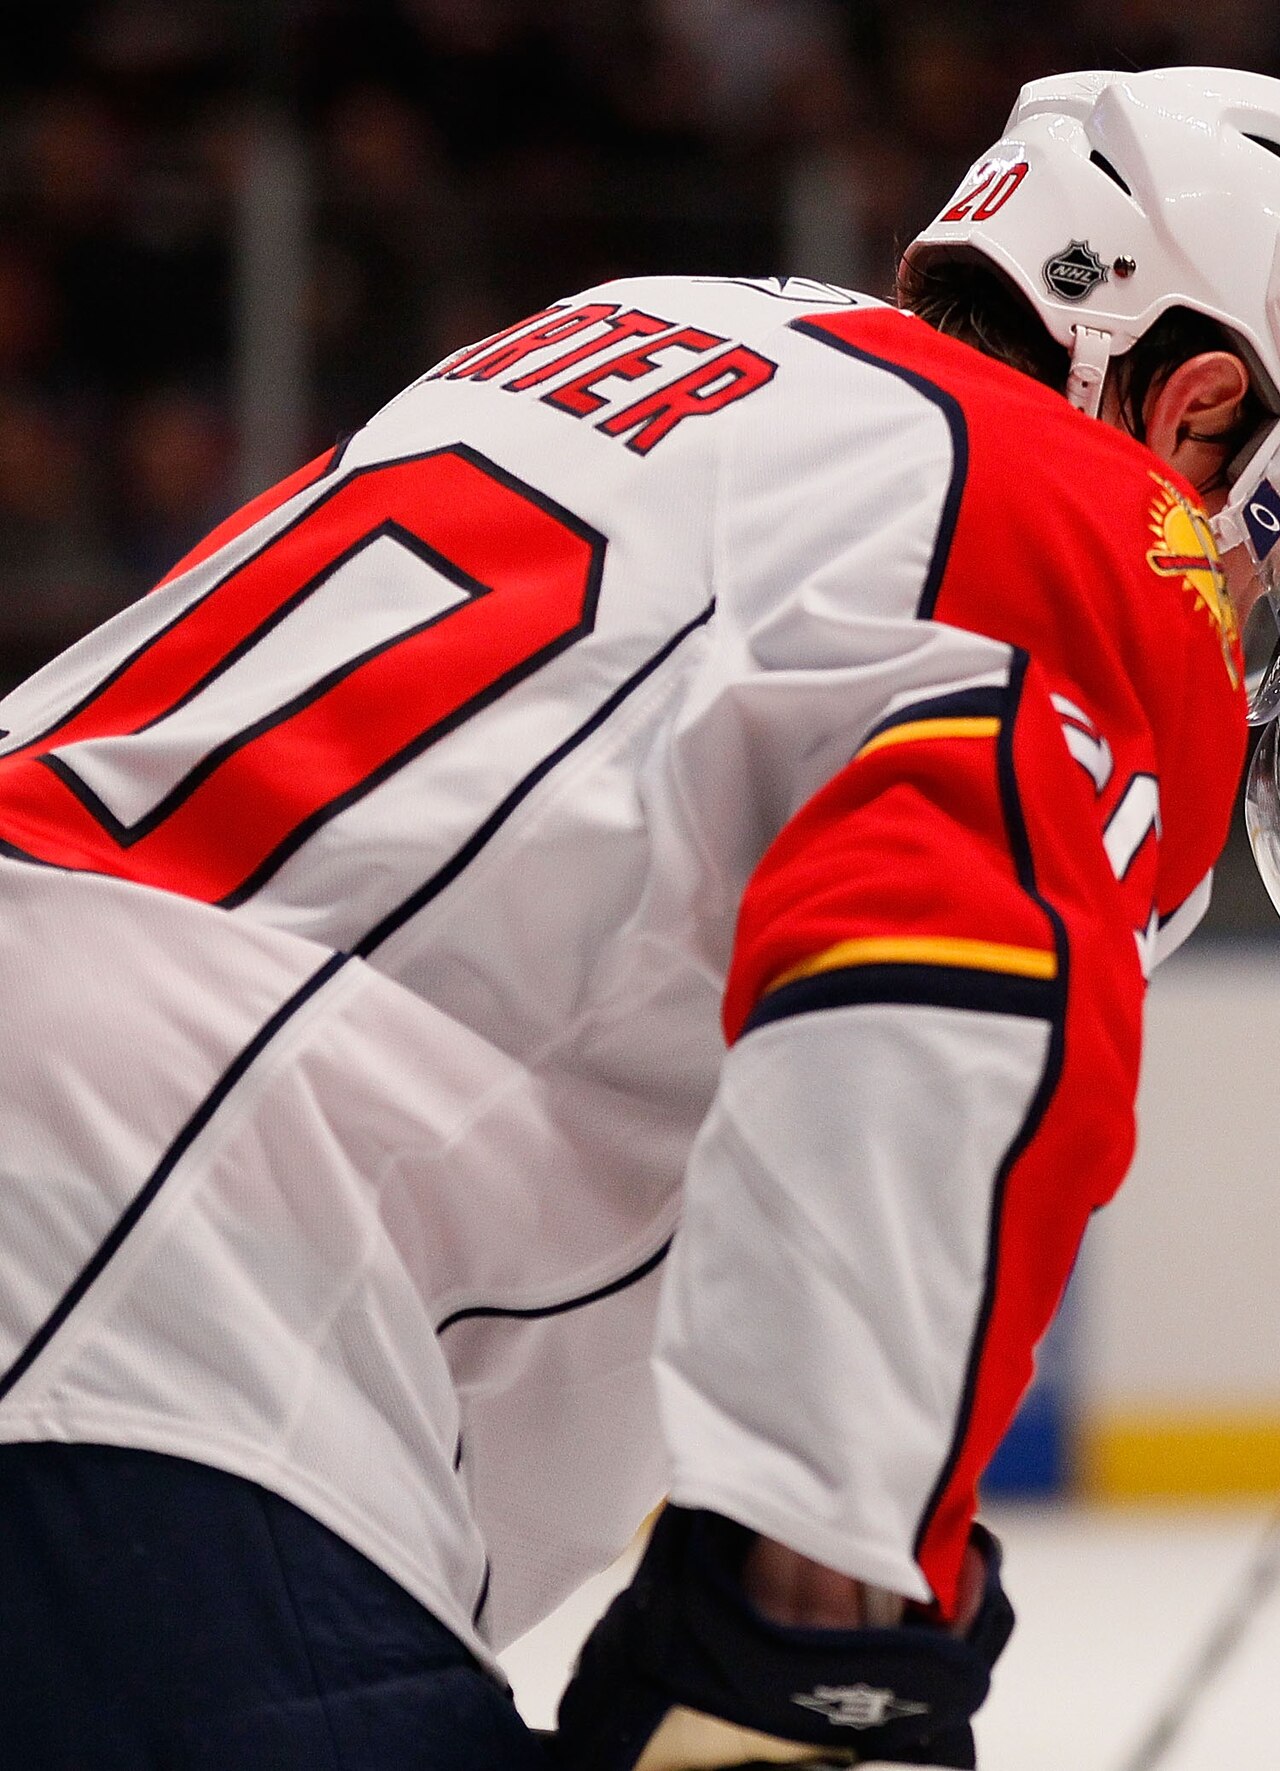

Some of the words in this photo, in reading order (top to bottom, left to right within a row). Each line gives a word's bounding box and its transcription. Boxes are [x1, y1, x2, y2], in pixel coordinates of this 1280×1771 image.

[940, 162, 1030, 222] 20
[1051, 263, 1095, 284] NHL
[425, 303, 780, 457] RTER
